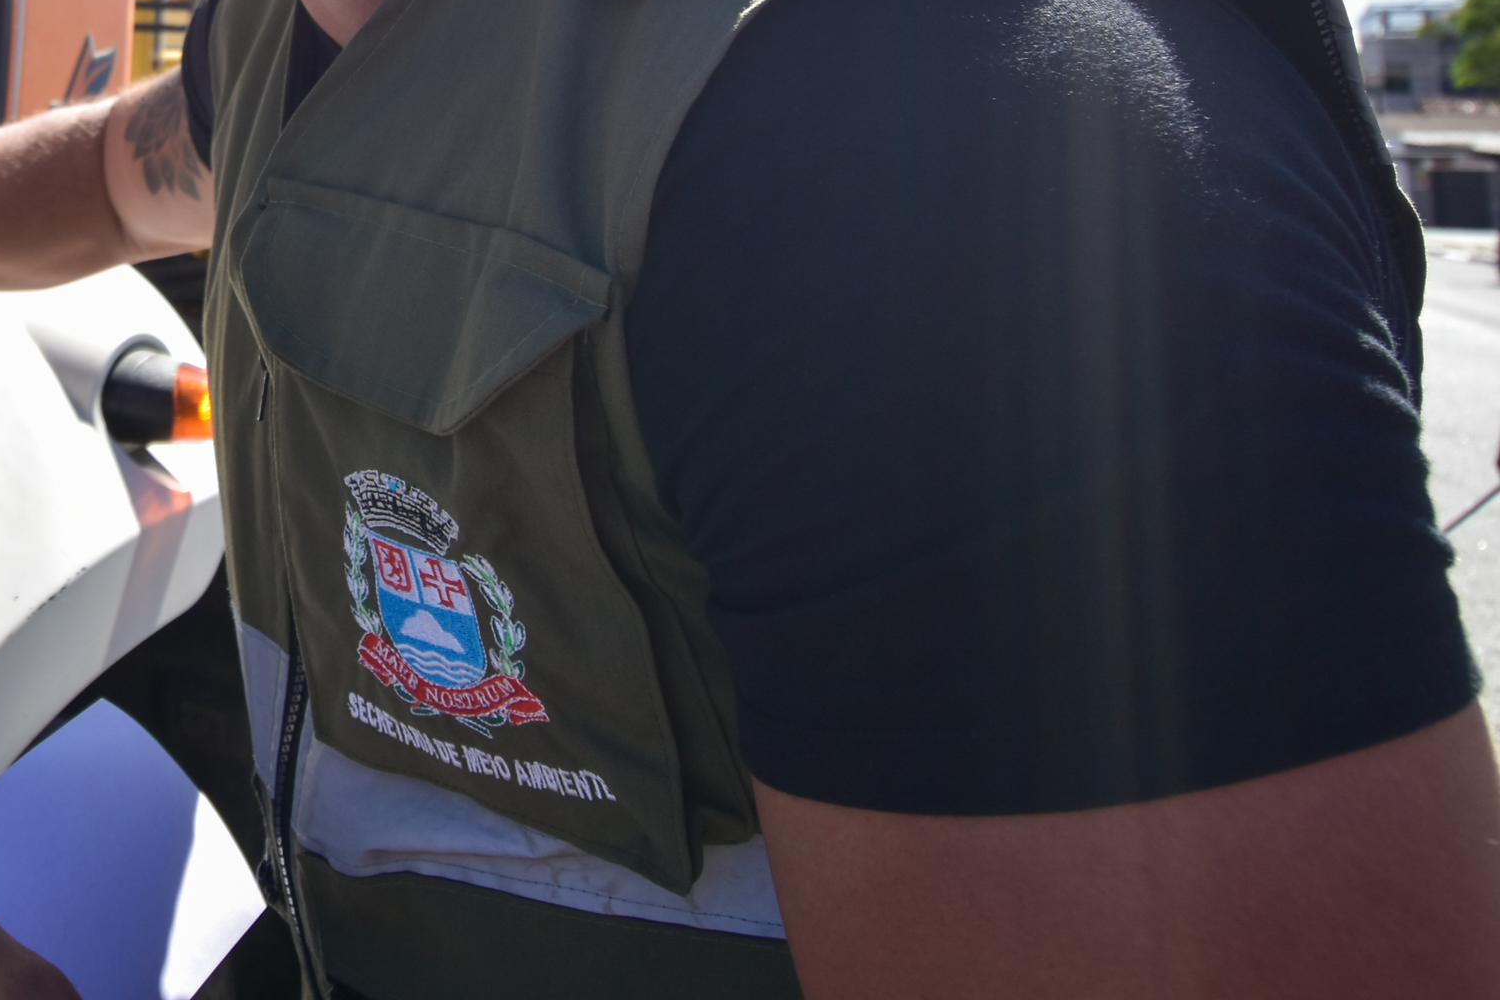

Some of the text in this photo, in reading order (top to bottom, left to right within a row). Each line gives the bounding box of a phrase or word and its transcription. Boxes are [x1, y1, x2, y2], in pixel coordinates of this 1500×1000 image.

[425, 678, 517, 710] NOSTRUM
[433, 740, 462, 769] DE
[462, 745, 511, 781] MEIO
[515, 759, 617, 802] AMBIENTE
